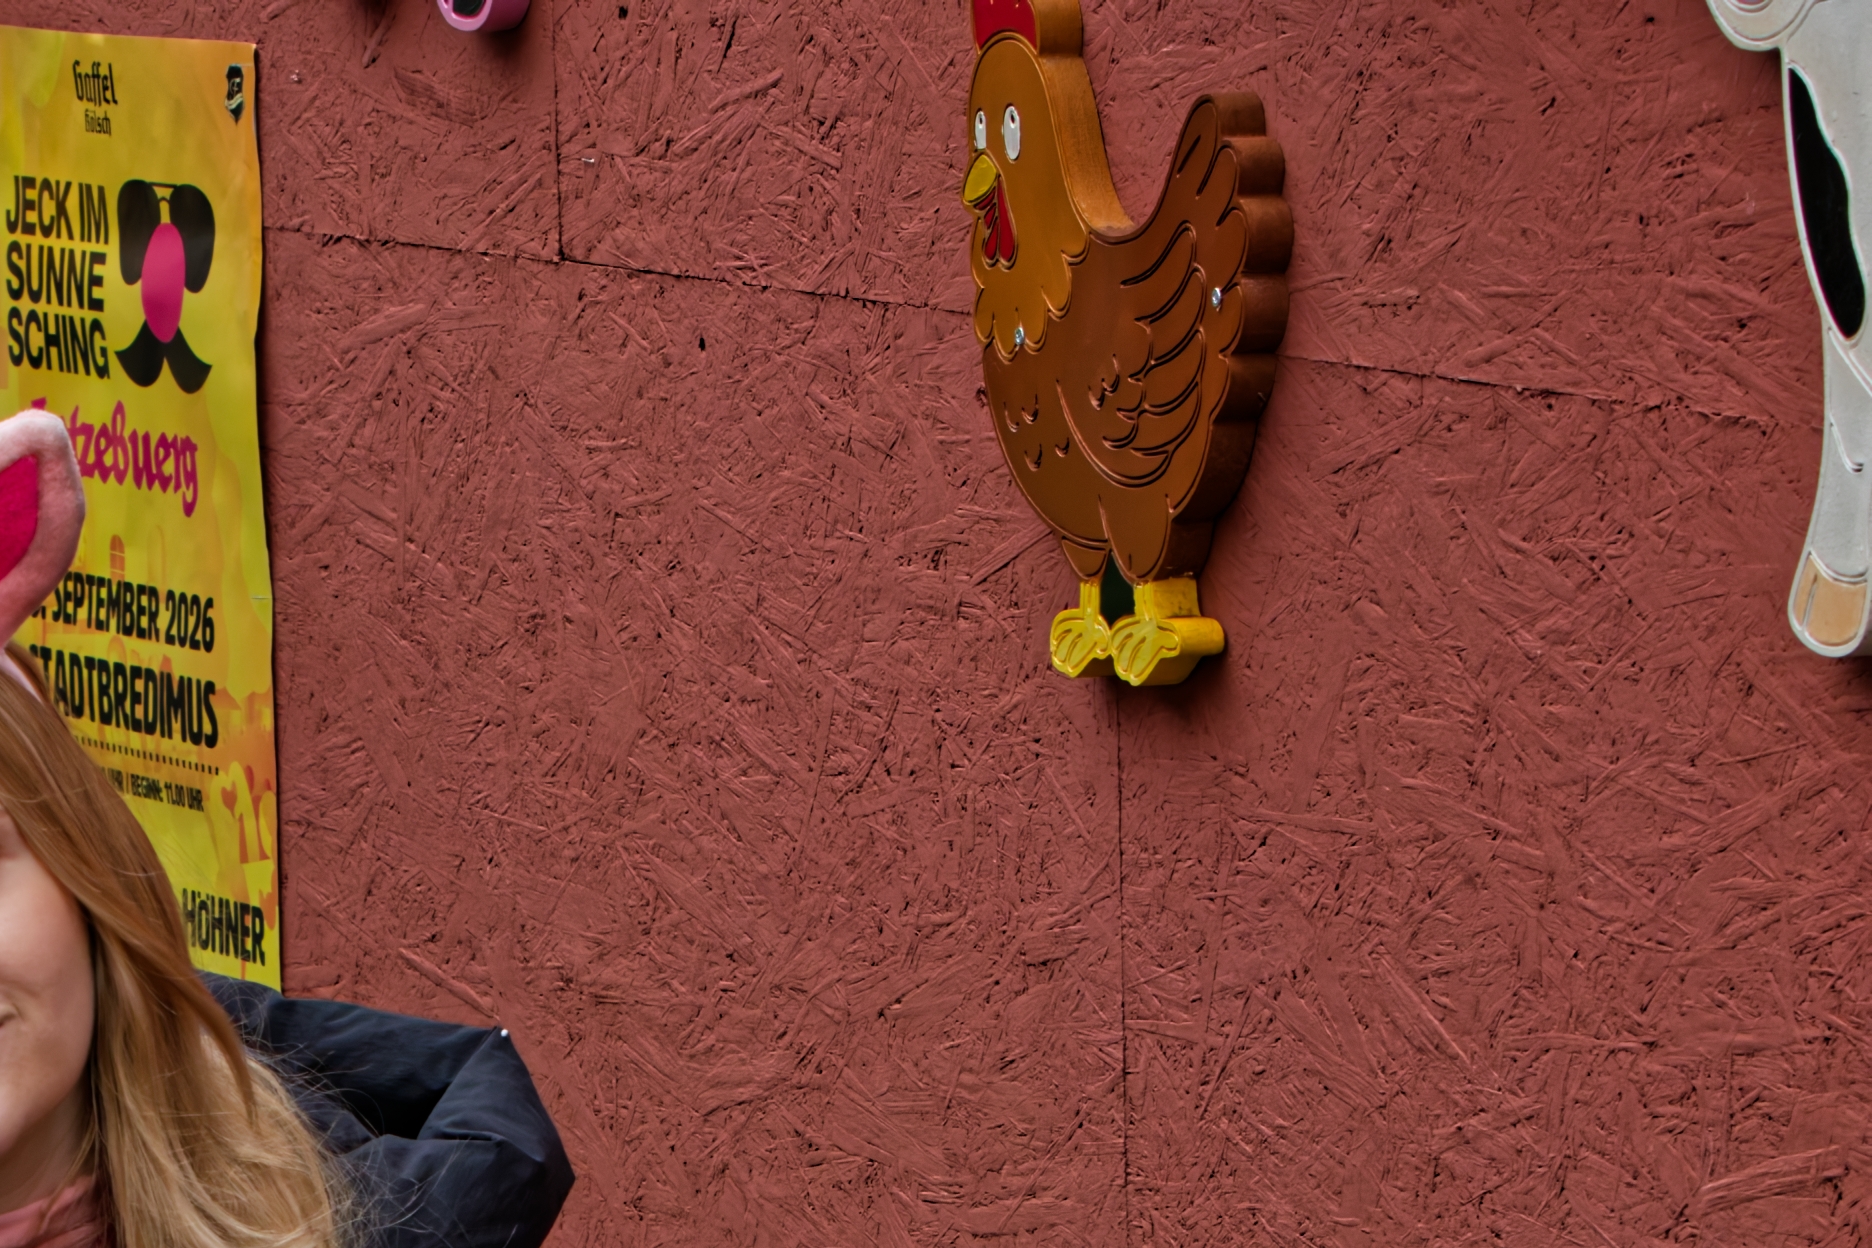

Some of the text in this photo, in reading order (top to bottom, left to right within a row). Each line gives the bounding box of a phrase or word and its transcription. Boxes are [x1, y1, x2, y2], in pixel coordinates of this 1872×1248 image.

[72, 59, 118, 107] Gaffel
[5, 174, 110, 246] JECK IM
[5, 240, 107, 313] SUNNE
[7, 306, 111, 380] SCHING
[52, 570, 215, 653] SEPTEMBER 2026
[29, 644, 219, 749] TADTBREDIMUS
[186, 786, 205, 812] UHR
[182, 887, 266, 967] HÖHNER
